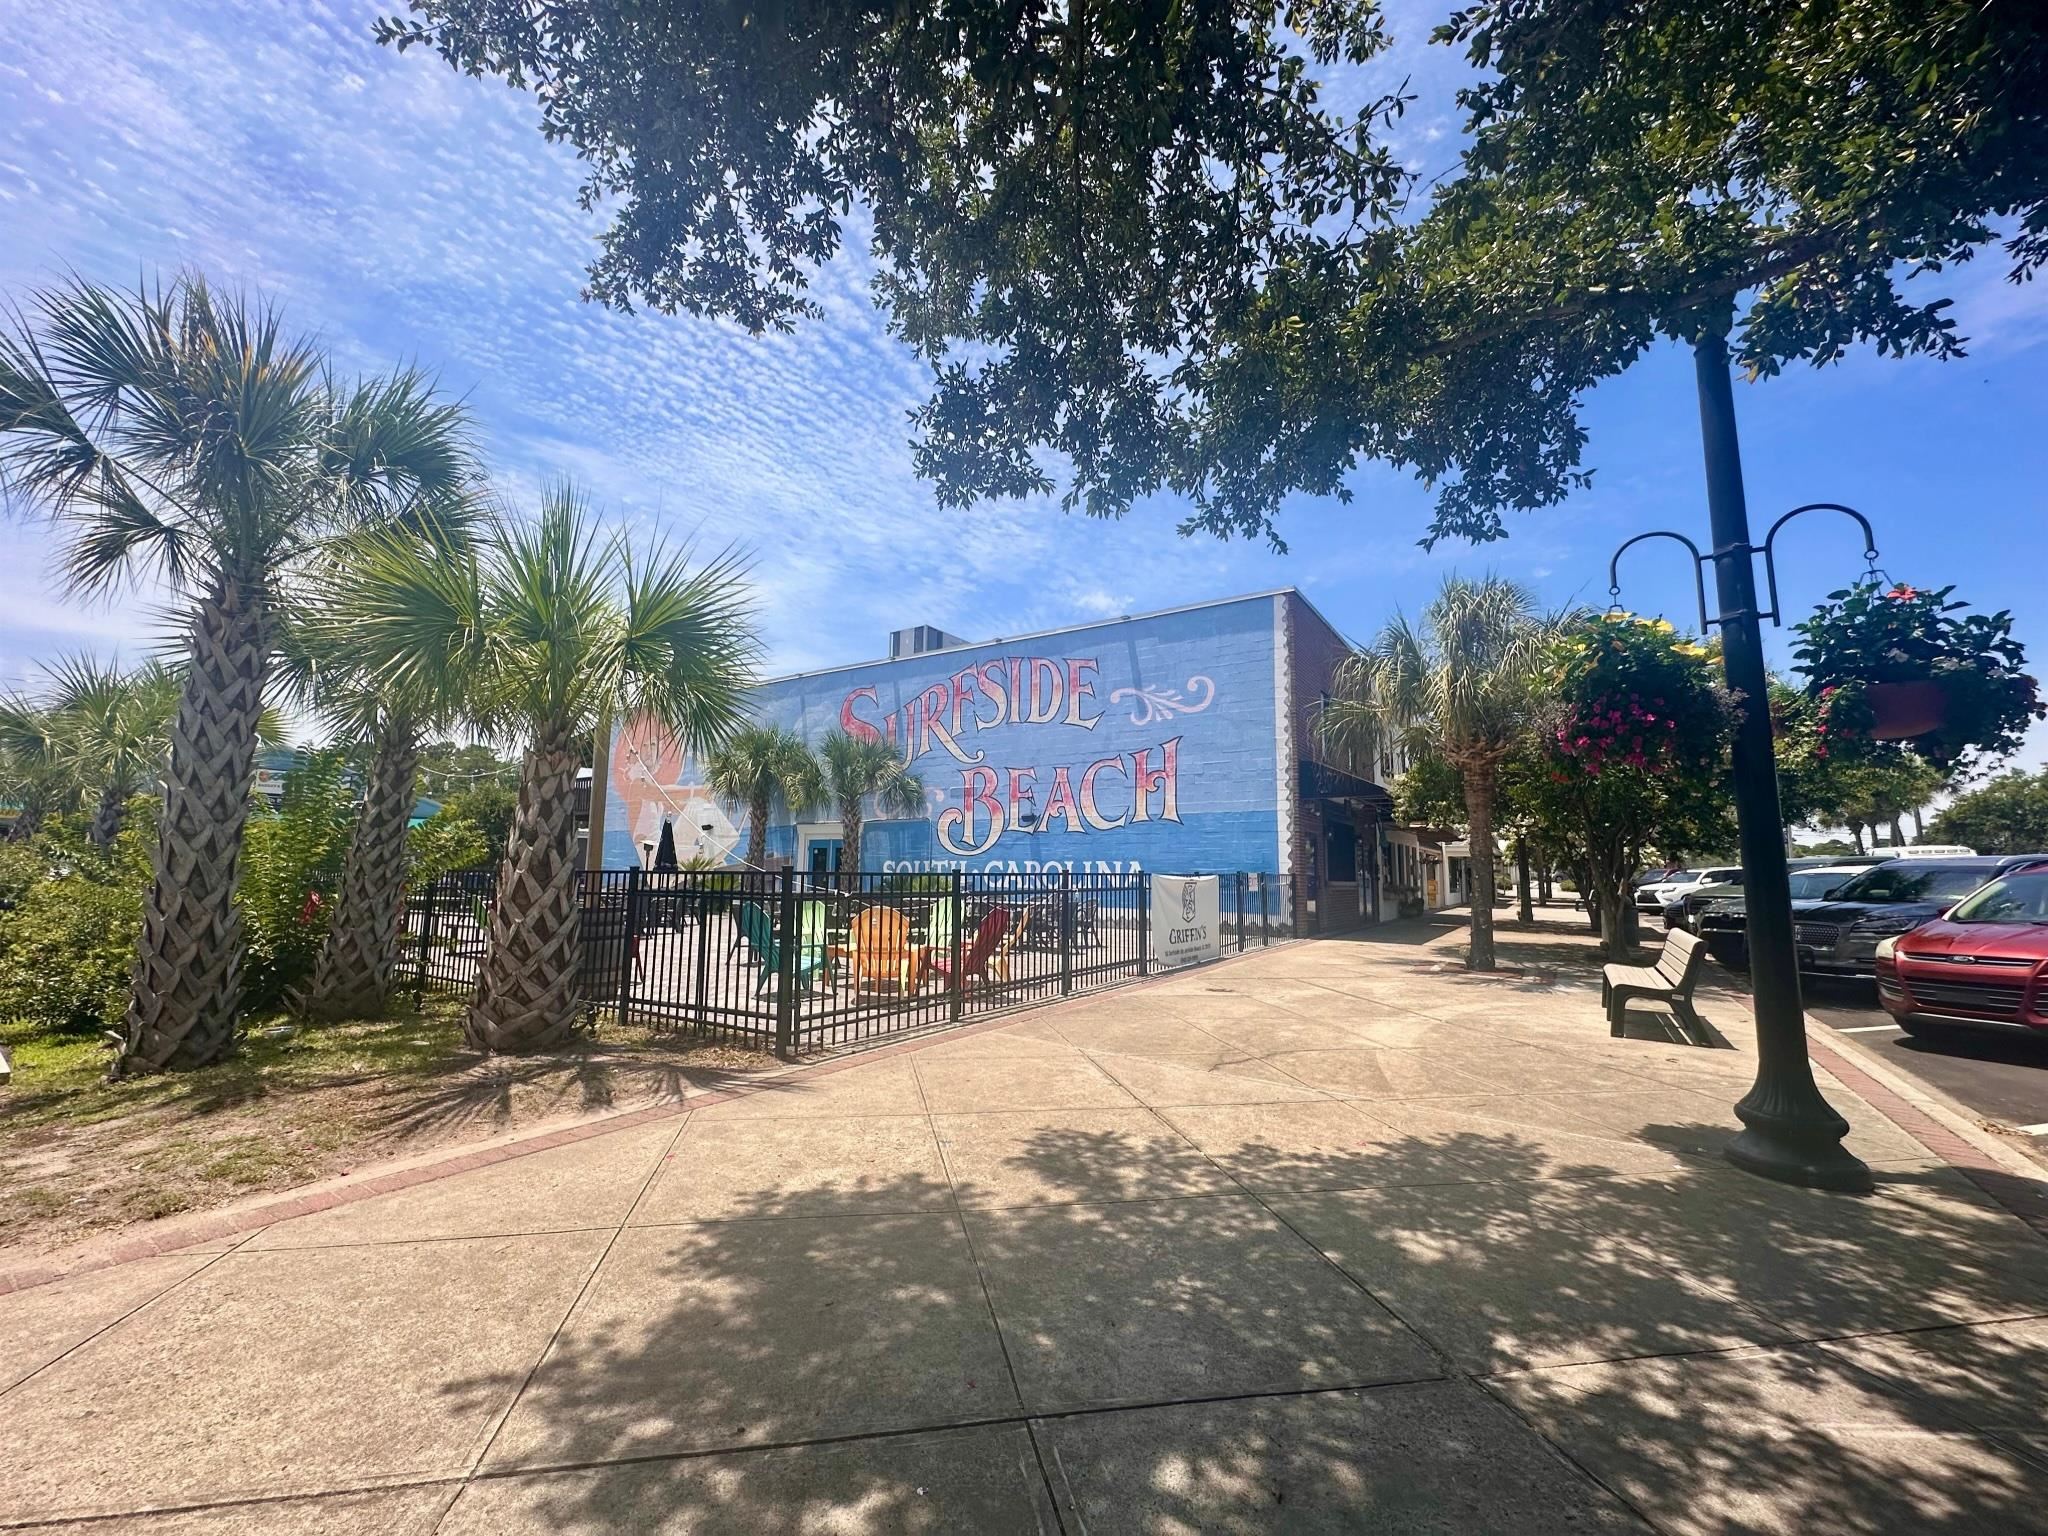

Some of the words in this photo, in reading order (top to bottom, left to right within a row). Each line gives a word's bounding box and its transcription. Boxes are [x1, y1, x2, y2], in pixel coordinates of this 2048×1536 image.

[840, 656, 1105, 771] SURFSIDE
[937, 735, 1184, 856] BEACH
[984, 860, 1149, 889] CAROLINA
